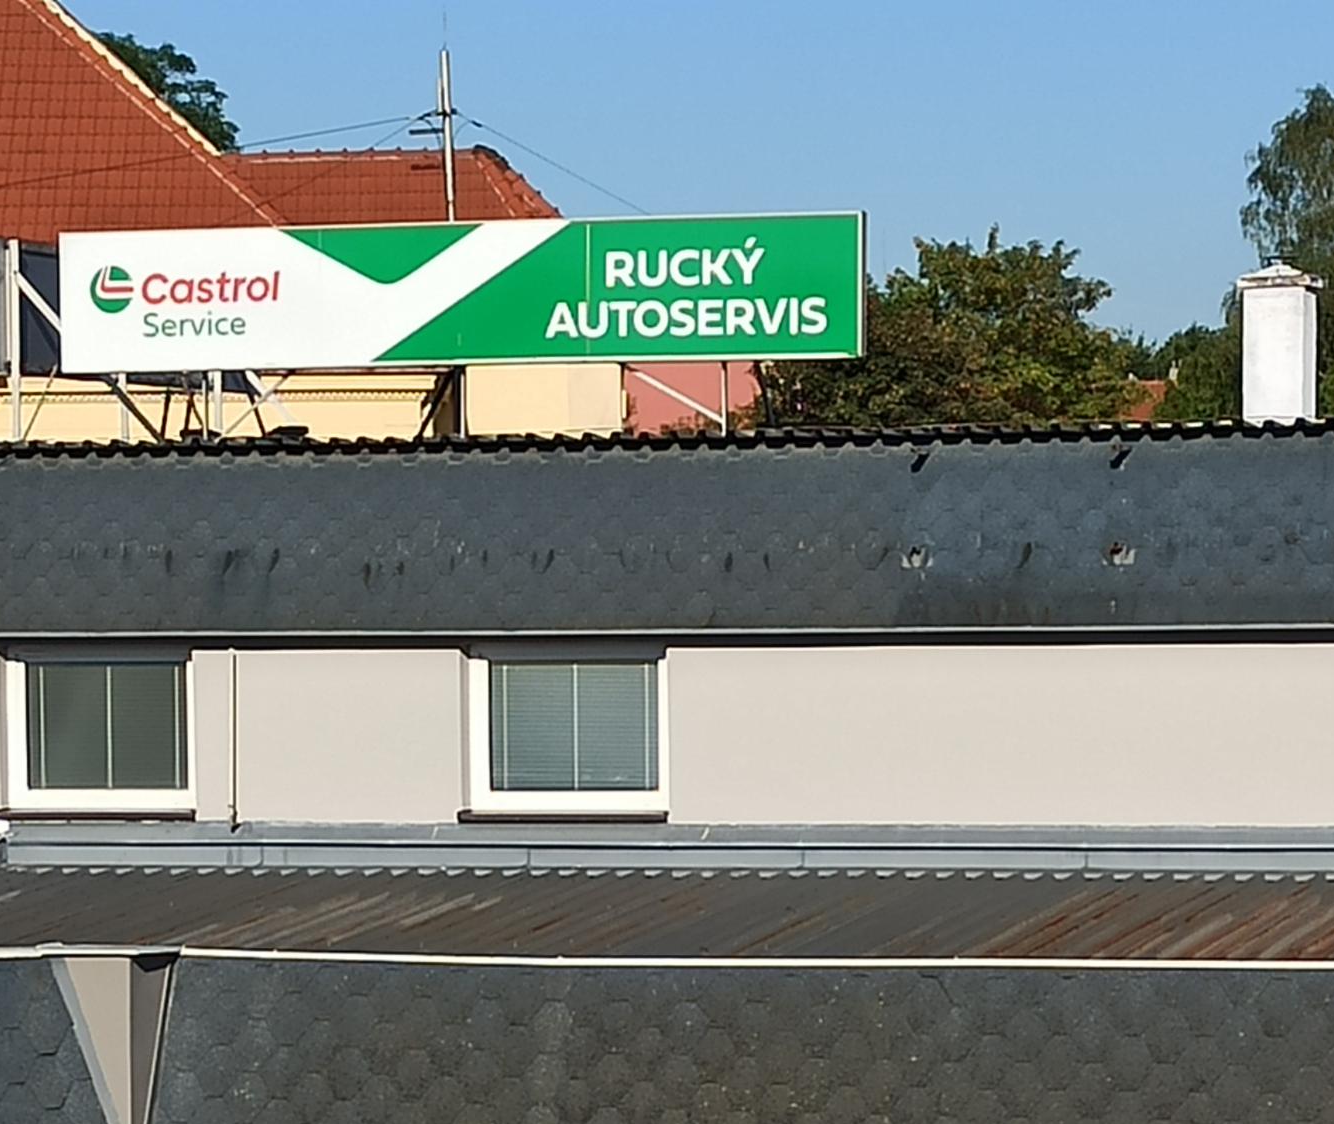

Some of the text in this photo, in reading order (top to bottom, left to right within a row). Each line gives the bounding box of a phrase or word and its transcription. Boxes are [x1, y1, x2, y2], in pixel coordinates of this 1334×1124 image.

[605, 237, 765, 288] RUCKÝ
[142, 270, 280, 304] Castrol
[143, 311, 246, 337] Service
[545, 297, 827, 339] AUTOSERVIS
